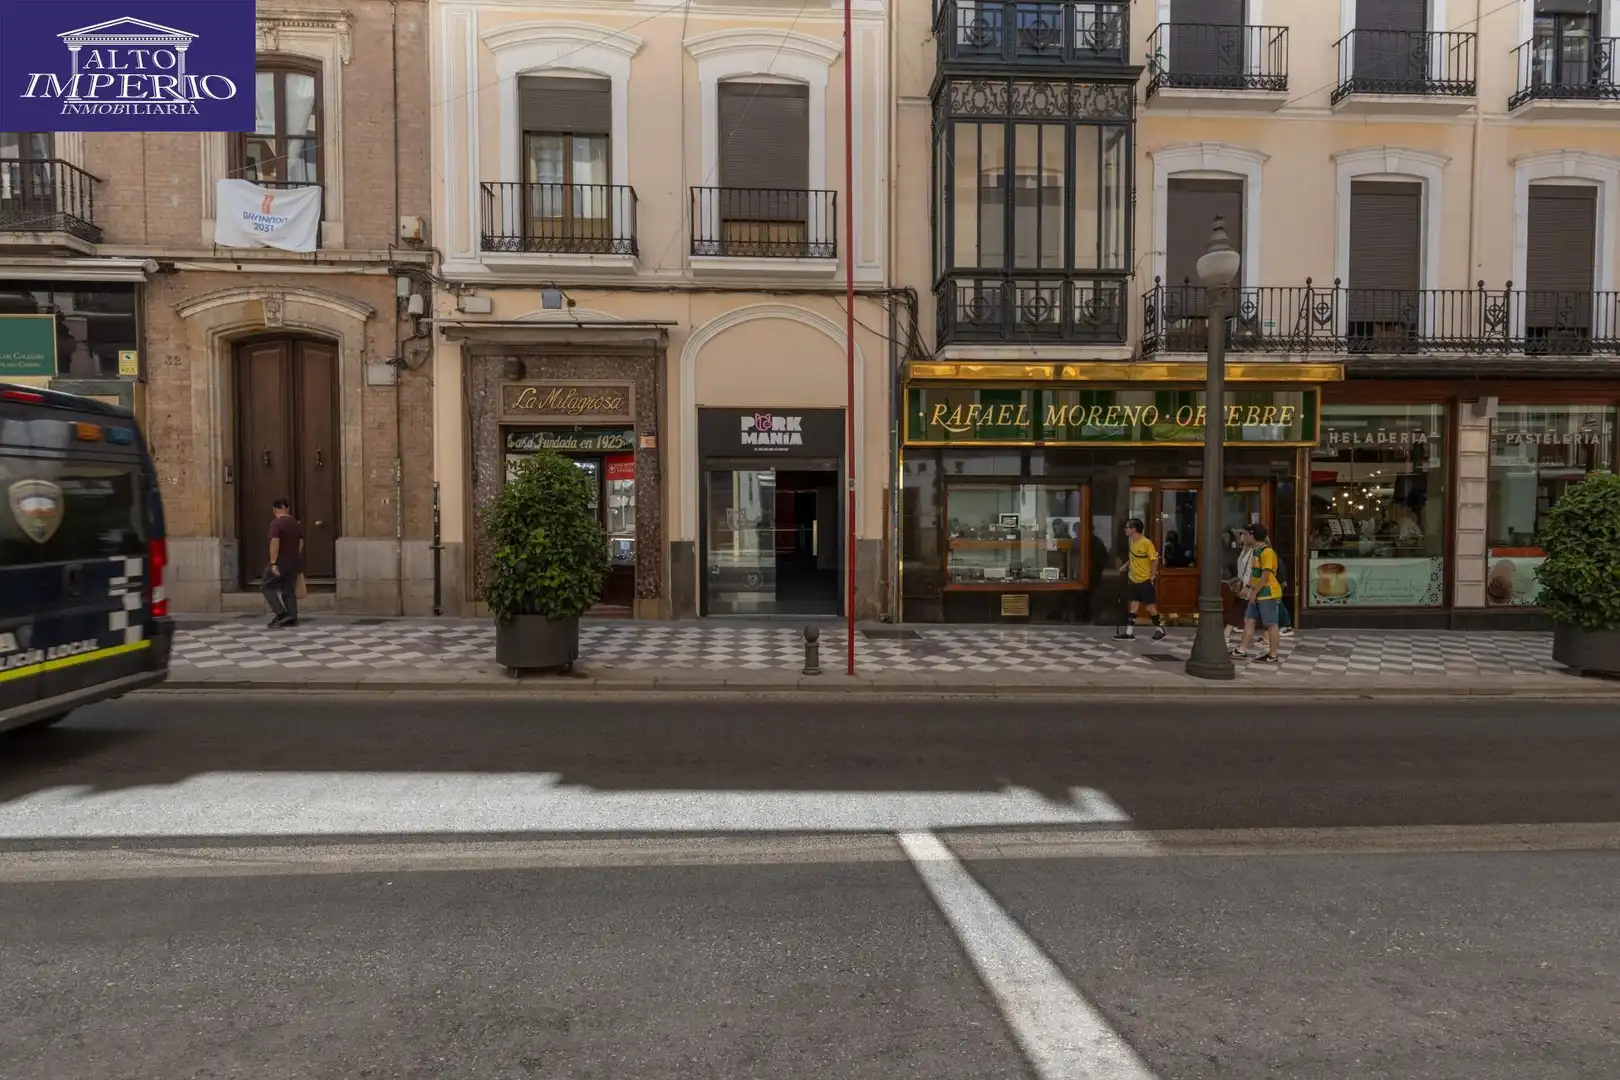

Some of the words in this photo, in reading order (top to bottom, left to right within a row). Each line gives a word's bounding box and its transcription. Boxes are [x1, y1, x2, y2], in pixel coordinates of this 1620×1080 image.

[243, 212, 288, 224] GRANADA
[254, 222, 274, 232] 2031
[513, 387, 537, 409] La
[539, 388, 622, 415] Milagrosa
[930, 404, 1030, 432] RAFAEL
[1043, 404, 1159, 431] MORENO
[1176, 405, 1295, 428] OREBRE
[507, 432, 534, 449] Casa
[534, 432, 577, 449] Fundada
[580, 439, 593, 449] en
[596, 436, 623, 449] 1925
[46, 638, 100, 660] LOCAL
